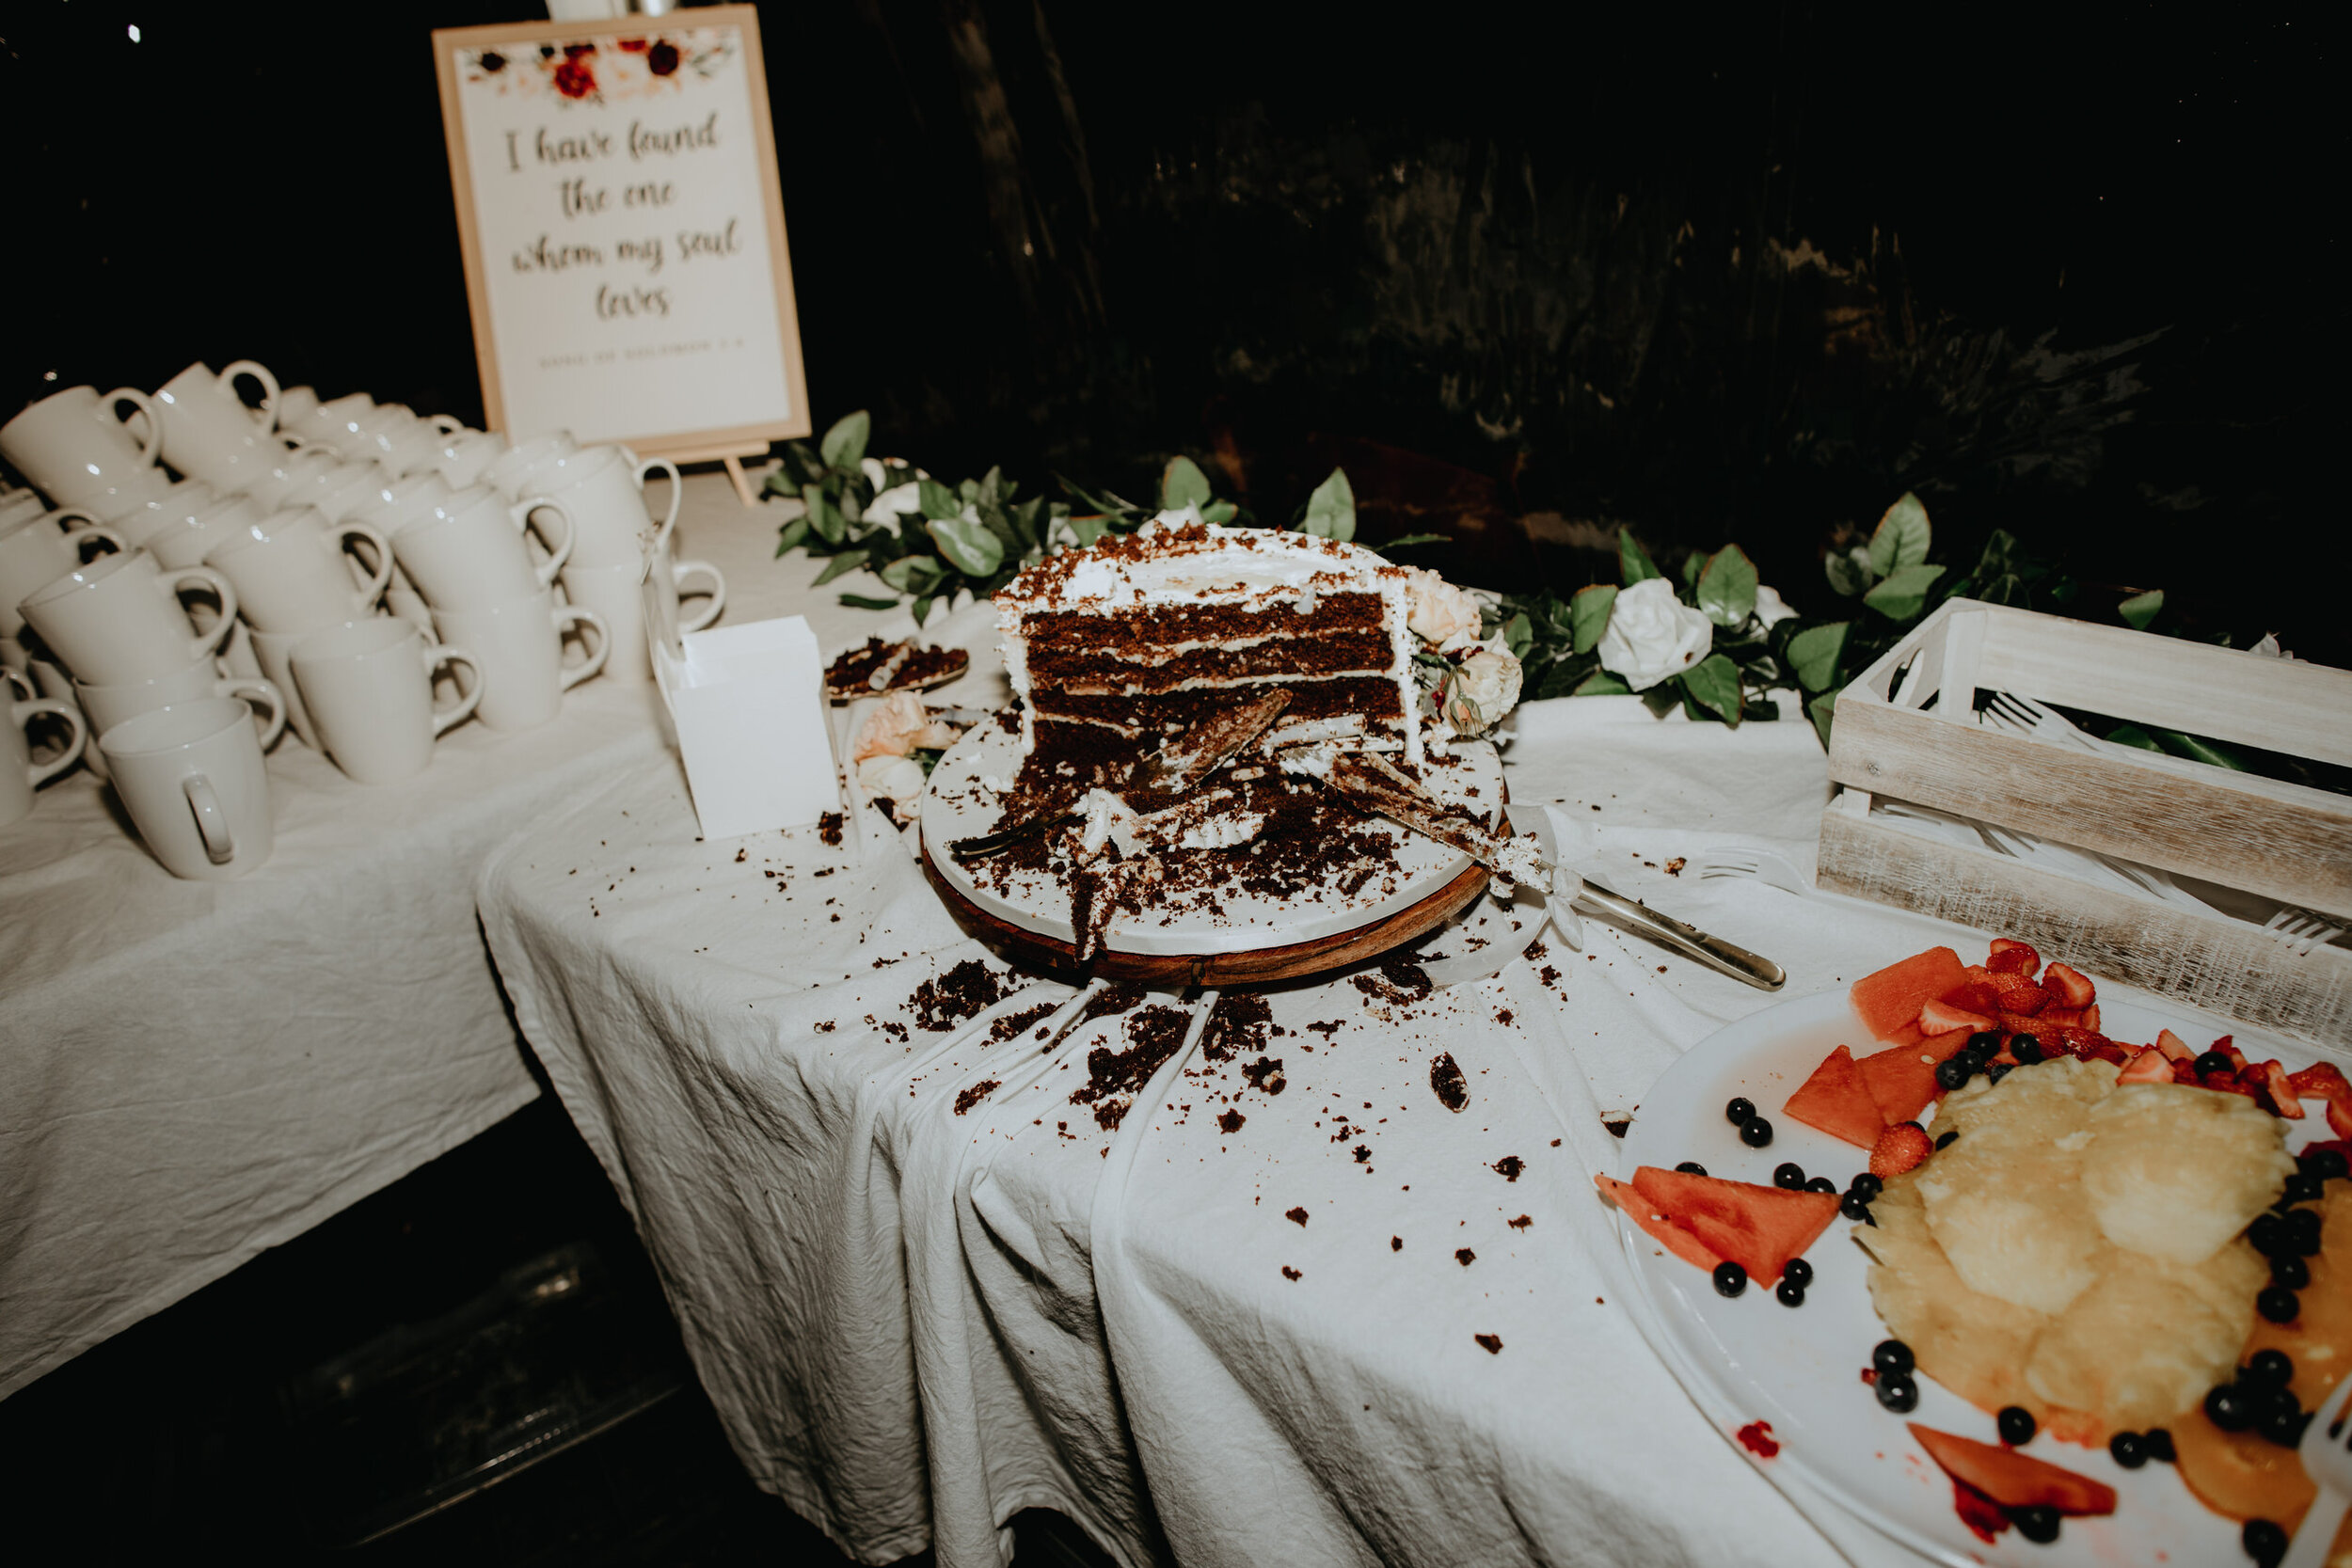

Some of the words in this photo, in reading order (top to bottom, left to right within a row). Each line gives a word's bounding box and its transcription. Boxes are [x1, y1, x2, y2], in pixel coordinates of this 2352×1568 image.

[505, 130, 524, 173] I
[533, 126, 615, 166] have
[627, 110, 720, 163] found
[556, 175, 611, 220] the
[623, 180, 675, 210] one
[510, 231, 605, 275] whom
[615, 236, 665, 276] my
[675, 216, 739, 263] soul
[595, 282, 672, 322] loves
